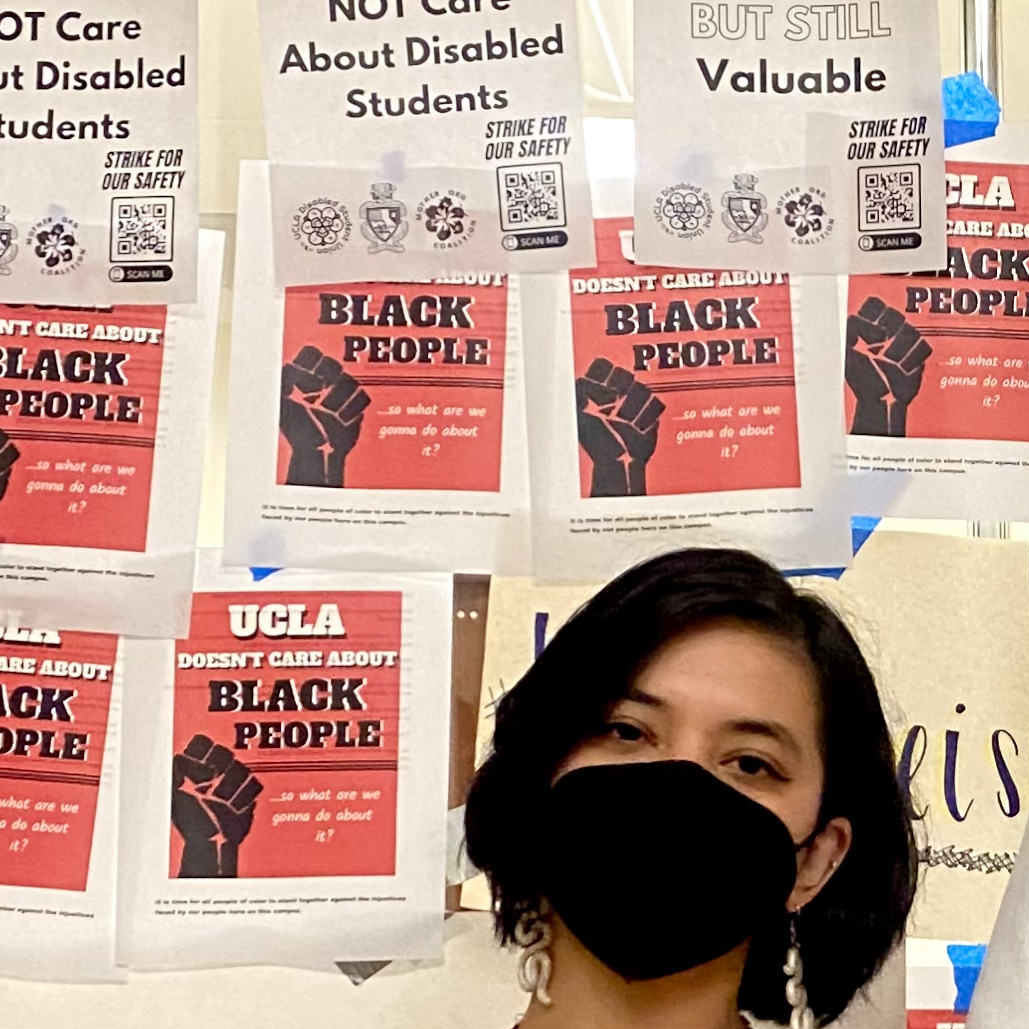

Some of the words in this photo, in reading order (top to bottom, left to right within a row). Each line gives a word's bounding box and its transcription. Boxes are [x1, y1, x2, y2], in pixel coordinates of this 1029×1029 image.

[0, 11, 45, 41] OT
[56, 12, 142, 40] Care
[691, 3, 772, 40] BUT
[784, 1, 891, 41] STILL
[279, 42, 395, 74] About
[406, 23, 563, 66] Disabled
[37, 55, 185, 90] Disabled
[696, 57, 886, 94] Valuable
[346, 84, 508, 117] Students
[0, 109, 129, 139] tudents
[485, 119, 535, 138] STRIKE
[539, 116, 567, 134] FOR
[849, 120, 897, 138] STRIKE
[900, 116, 927, 135] FOR
[105, 151, 154, 168] STRIKE
[157, 149, 183, 167] FOR
[485, 142, 514, 160] OUR
[518, 137, 571, 157] SAFETY
[847, 142, 874, 160] OUR
[879, 138, 930, 159] SAFETY
[103, 172, 130, 190] OUR
[134, 171, 185, 189] SAFETY
[520, 236, 544, 246] SCAN
[548, 235, 559, 244] ME
[876, 238, 899, 247] SCAN
[902, 237, 913, 246] ME
[127, 270, 148, 279] SCAN
[151, 270, 164, 278] ME
[662, 273, 714, 289] CARE
[718, 272, 787, 287] ABOUT
[319, 293, 474, 328] BLACK
[604, 296, 760, 336] BLACK
[36, 322, 90, 340] CARE
[92, 325, 161, 344] ABOUT
[343, 335, 491, 365] PEOPLE
[633, 337, 778, 371] PEOPLE
[0, 347, 130, 386] LACK
[968, 356, 999, 368] what
[1004, 358, 1022, 368] are
[940, 376, 977, 390] gonna
[983, 375, 997, 387] do
[702, 406, 732, 418] what
[739, 407, 757, 417] are
[763, 405, 780, 415] we
[983, 395, 1000, 407] it?
[677, 428, 713, 444] gonna
[720, 425, 734, 437] do
[739, 424, 774, 436] about
[721, 445, 739, 457] it?
[228, 603, 346, 639] UCLA
[39, 660, 111, 680] ABOUT
[269, 652, 323, 668] CARE
[326, 651, 398, 667] ABOUT
[208, 677, 367, 713] BLACK
[234, 719, 384, 750] PEOPLE
[300, 789, 331, 801] what
[337, 790, 357, 800] are
[362, 789, 381, 800] we
[272, 812, 310, 825] gonna
[315, 809, 330, 822] do
[337, 809, 372, 822] about
[315, 829, 334, 842] it?
